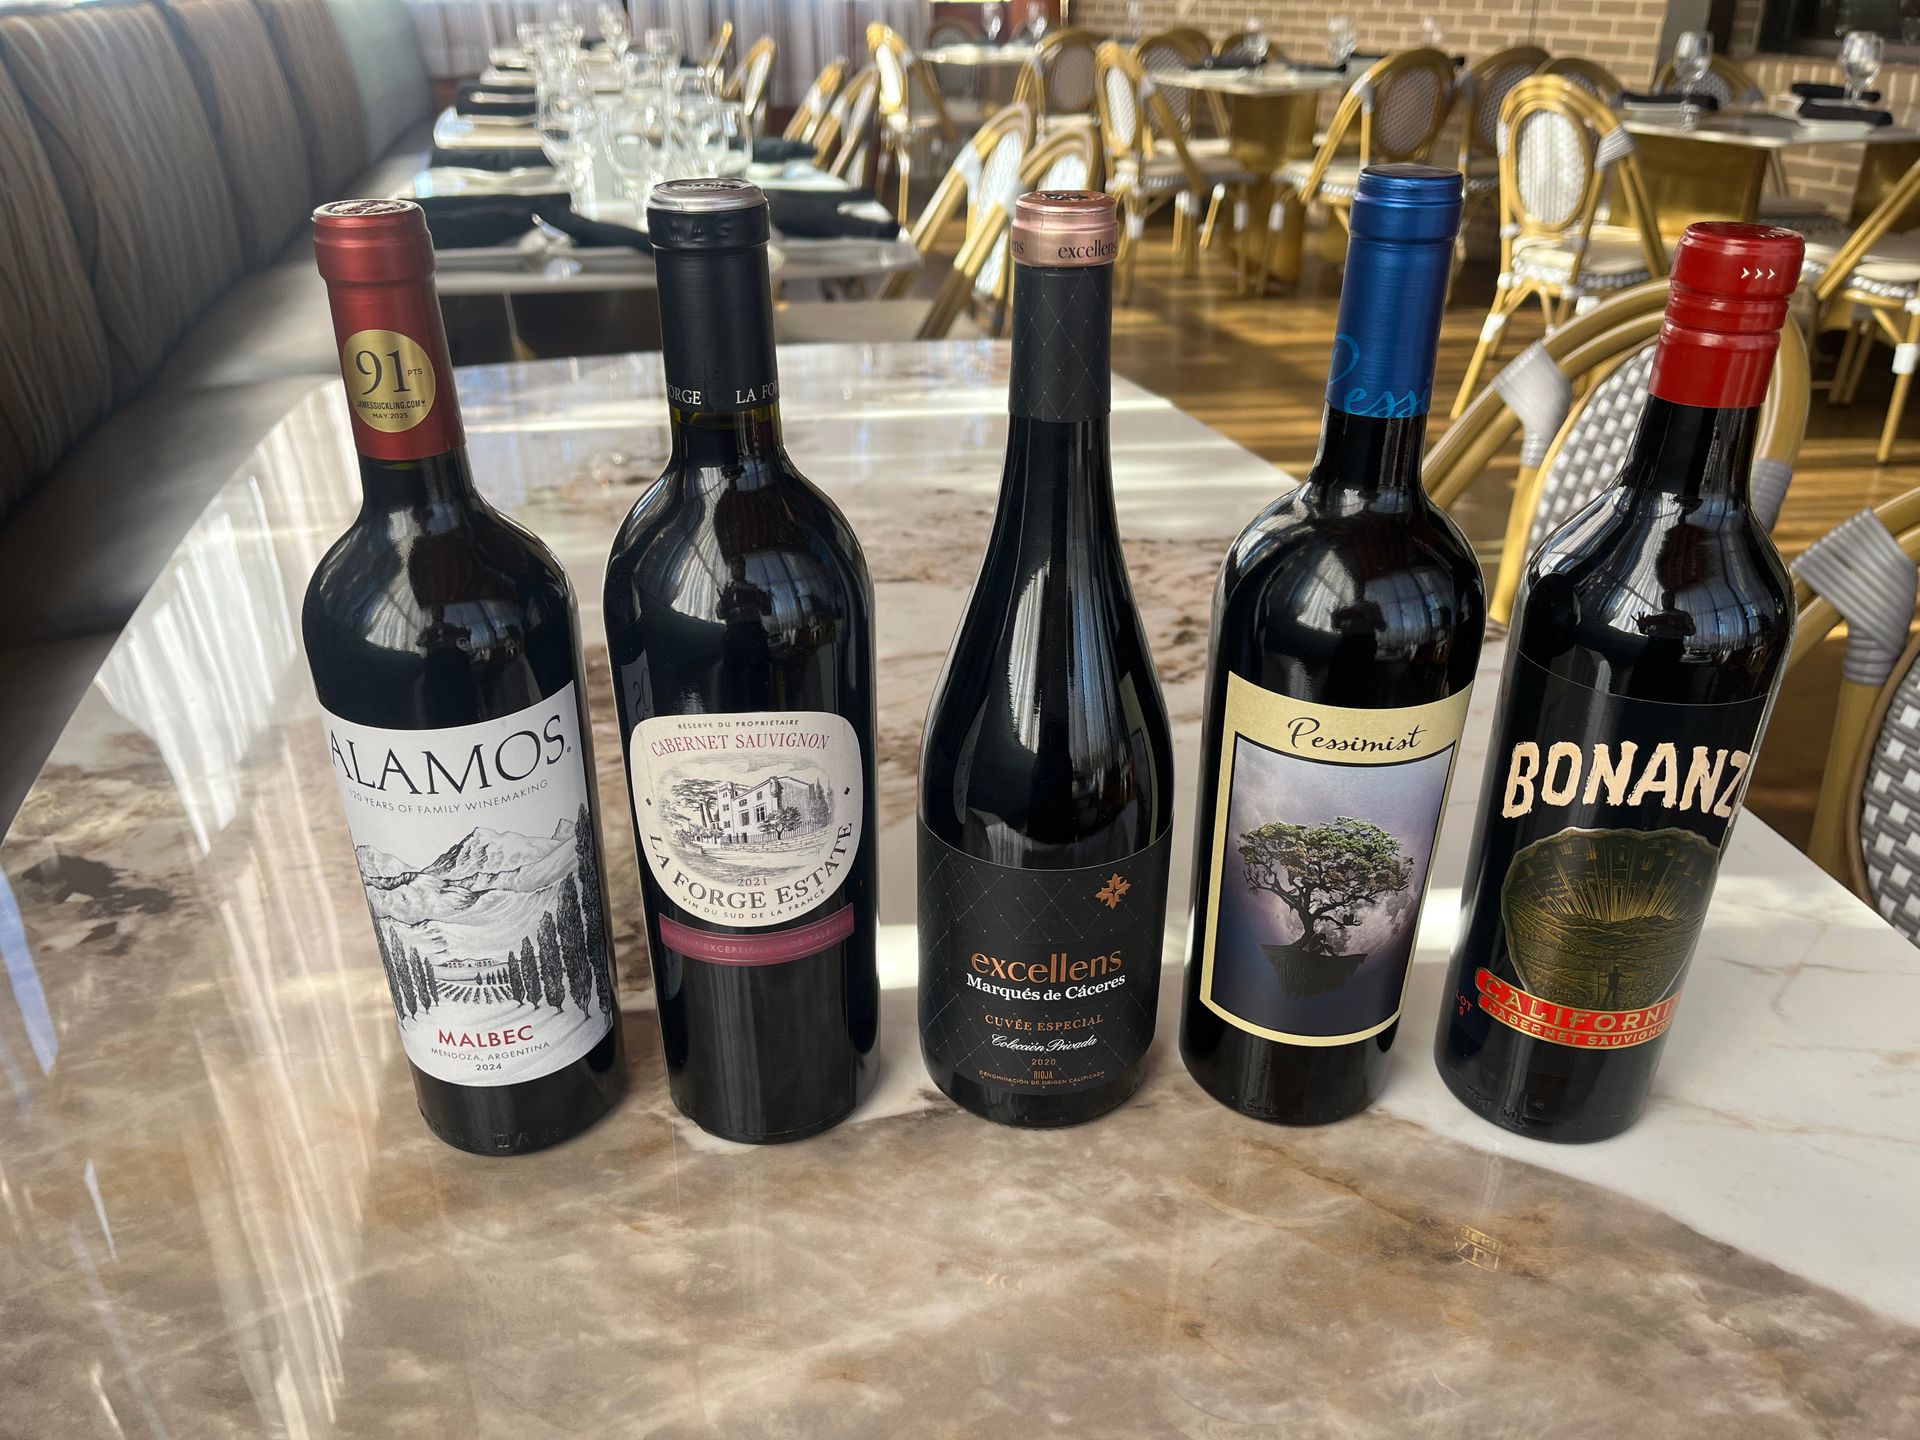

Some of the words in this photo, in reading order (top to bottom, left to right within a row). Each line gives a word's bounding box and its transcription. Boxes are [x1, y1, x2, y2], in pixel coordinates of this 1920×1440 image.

[356, 350, 411, 396] 91
[407, 368, 423, 376] PTS
[357, 400, 420, 410] JAMESSUCKLING.COM
[666, 382, 702, 405] ORGE
[735, 388, 757, 404] LA
[736, 718, 799, 727] PROPRIÉTAIRE
[1287, 716, 1427, 752] Pessimist
[331, 714, 565, 795] ALAMOS
[651, 735, 729, 757] CABERNET
[735, 732, 830, 750] SAUVIGNON
[350, 788, 362, 801] 120
[364, 796, 394, 811] YEARS
[398, 804, 412, 813] OF
[418, 804, 460, 814] FAMILY
[465, 779, 549, 811] WINEMAKING
[649, 834, 671, 870] LA
[672, 870, 767, 909] FORGE
[774, 822, 853, 905] ESTATE
[737, 878, 768, 887] 2021
[682, 896, 699, 909] VIN
[704, 906, 718, 916] DU
[770, 909, 783, 917] LA
[788, 889, 825, 911] FRANCE
[971, 950, 1122, 984] excellens
[966, 972, 1040, 1001] Marqués
[1043, 988, 1062, 1001] de
[1065, 972, 1126, 1000] Cáceres
[1455, 987, 1473, 1012] LOT
[985, 1014, 1032, 1031] CUVÉE
[1037, 1014, 1104, 1031] ESPECIAL
[1488, 1002, 1578, 1044] CABERNET
[438, 1025, 534, 1048] MALBEC
[991, 1033, 1045, 1052] Colección
[1046, 1034, 1098, 1052] Privada
[431, 1047, 484, 1061] MENDOZA,
[487, 1041, 550, 1060] ARGENTINA
[1031, 1058, 1057, 1066] 2020
[475, 1062, 502, 1071] 2024
[979, 1069, 1029, 1085] DENOMINACIÓN
[1068, 1070, 1105, 1083] CALIFICADA
[1033, 1070, 1053, 1080] RIOJA
